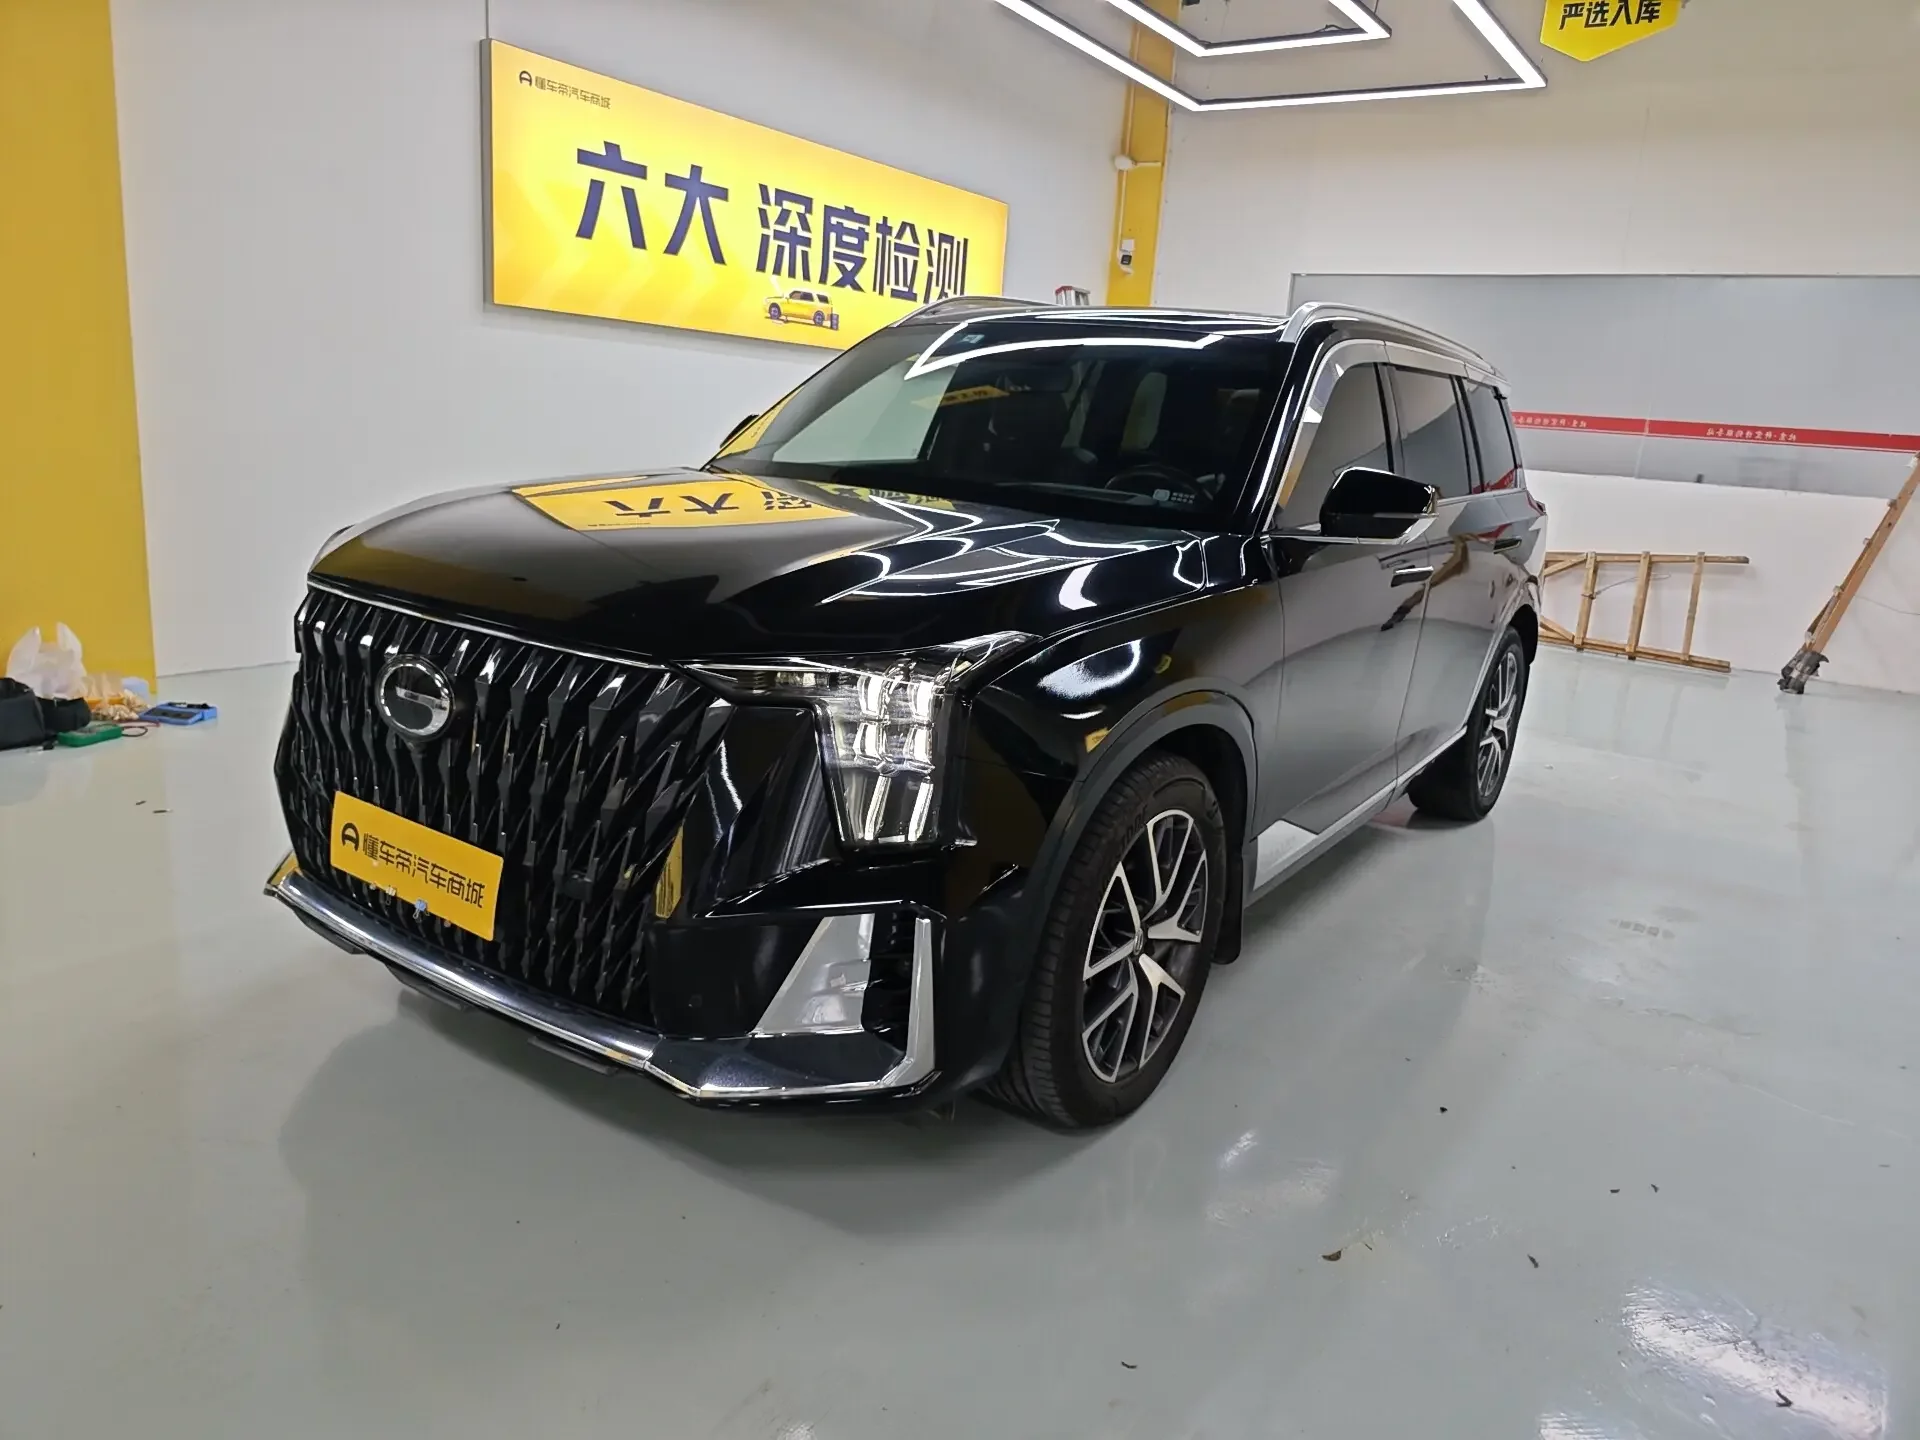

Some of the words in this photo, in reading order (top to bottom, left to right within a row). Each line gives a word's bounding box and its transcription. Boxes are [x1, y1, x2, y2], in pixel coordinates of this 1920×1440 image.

[1559, 0, 1661, 30] 严选入库
[535, 75, 611, 109] 懂车帝汽车商城
[575, 140, 729, 265] 六大
[755, 182, 969, 304] 深度检测
[362, 832, 486, 909] 懂车帝汽车商城
